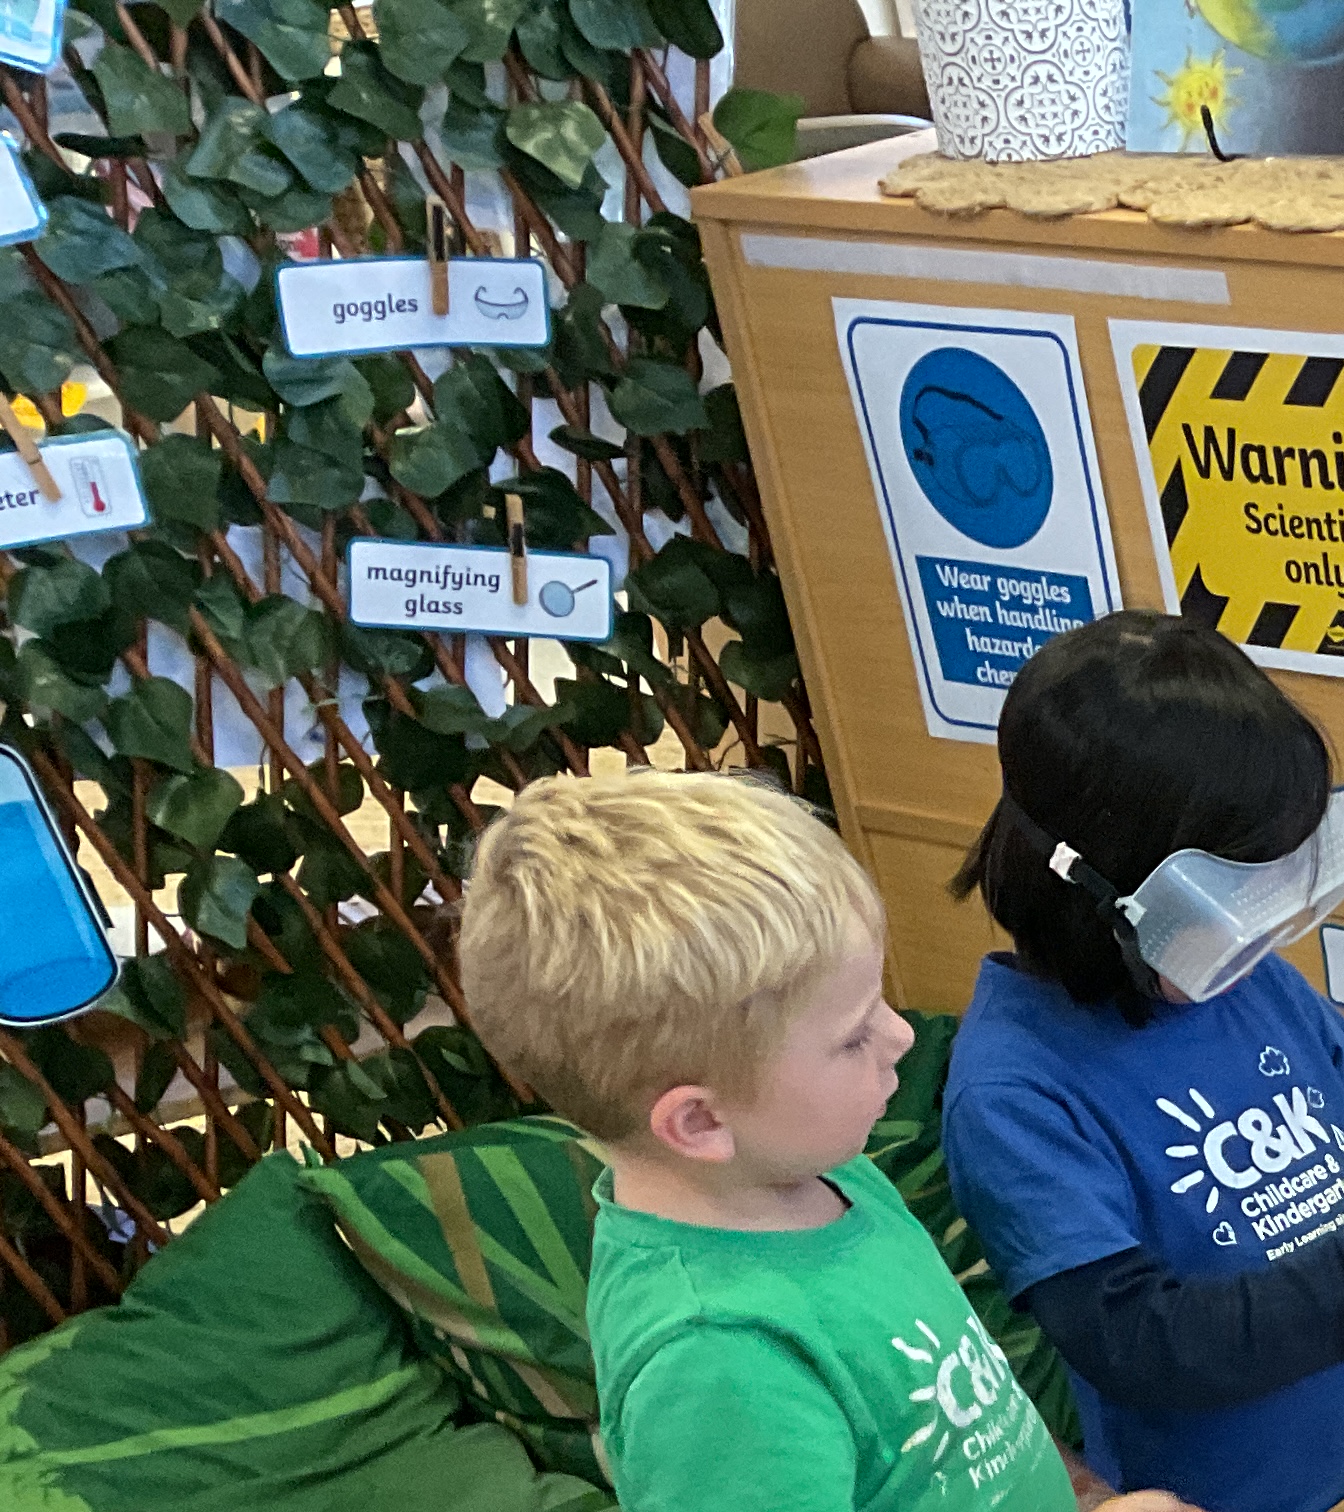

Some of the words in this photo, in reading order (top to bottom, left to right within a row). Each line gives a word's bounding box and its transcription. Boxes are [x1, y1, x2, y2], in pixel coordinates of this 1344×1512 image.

[331, 292, 419, 324] goggles
[367, 562, 503, 591] magnifying
[935, 564, 991, 591] Wear
[997, 576, 1071, 605] goggles
[405, 594, 464, 619] glass
[937, 597, 993, 623] when
[1203, 1086, 1331, 1190] C&K
[1241, 1163, 1328, 1218] Childcare
[1324, 1153, 1340, 1174] &
[1266, 1239, 1295, 1262] Early
[1294, 1219, 1337, 1248] Learning
